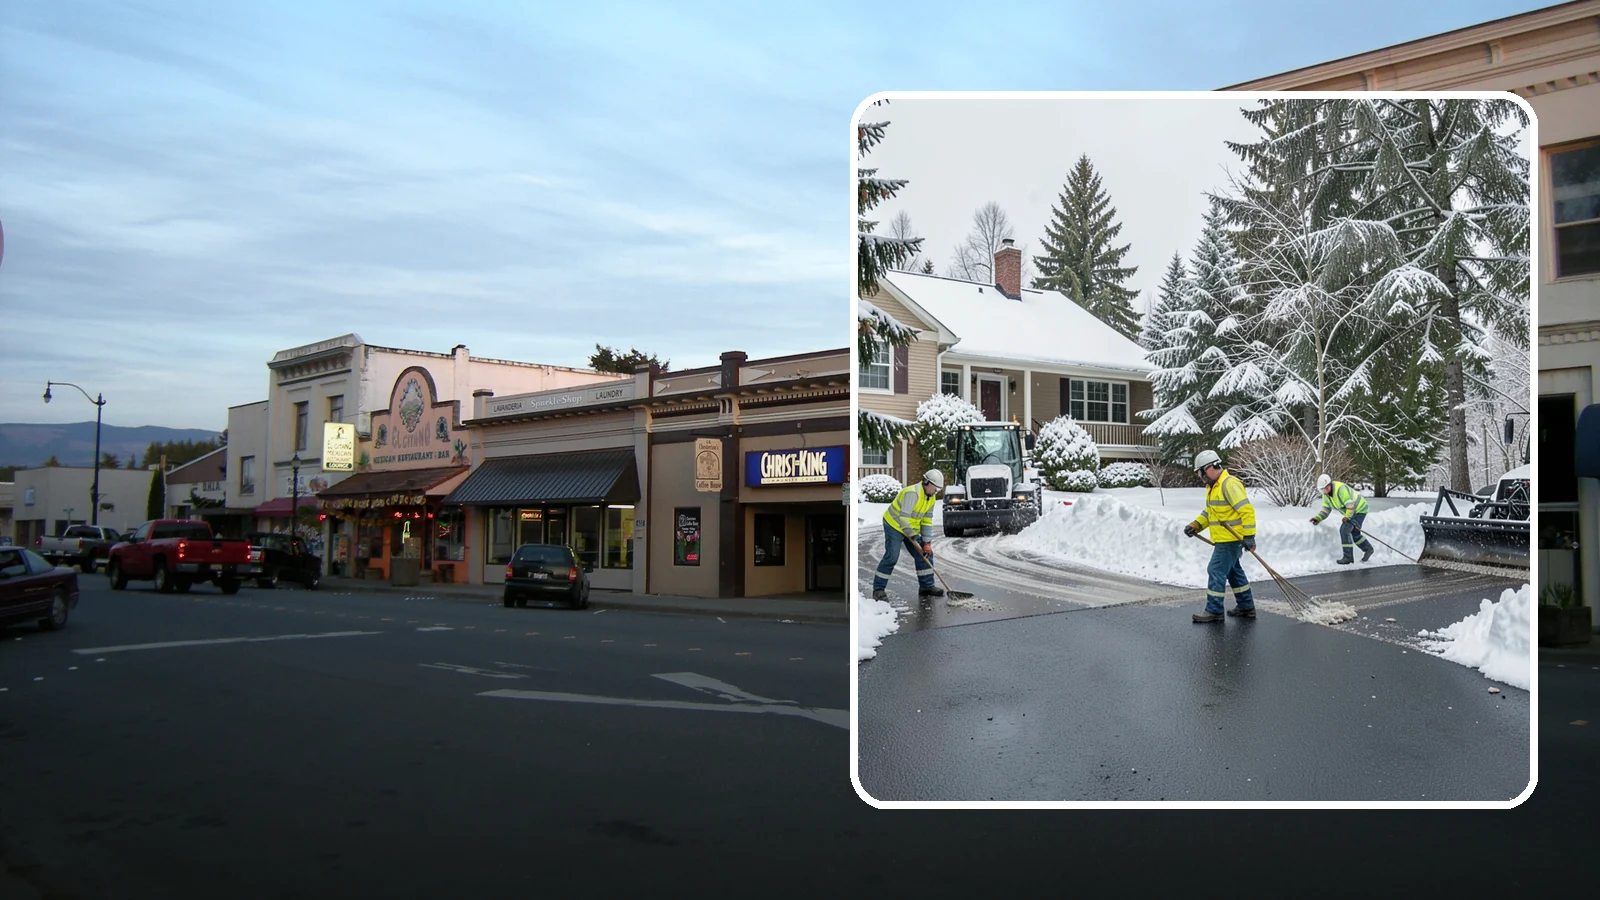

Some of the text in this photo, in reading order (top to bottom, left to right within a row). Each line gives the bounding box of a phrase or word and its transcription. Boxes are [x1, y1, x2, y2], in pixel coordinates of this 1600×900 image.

[595, 389, 623, 400] LAUNDRY
[493, 402, 522, 413] LAVANDERIA
[531, 394, 582, 409] Sparkle Shop
[373, 455, 396, 464] MEXICAN
[397, 451, 433, 463] RESTAURANT
[437, 450, 450, 459] BAR
[761, 450, 827, 478] CHRIST KING
[697, 481, 721, 489] Coffee House
